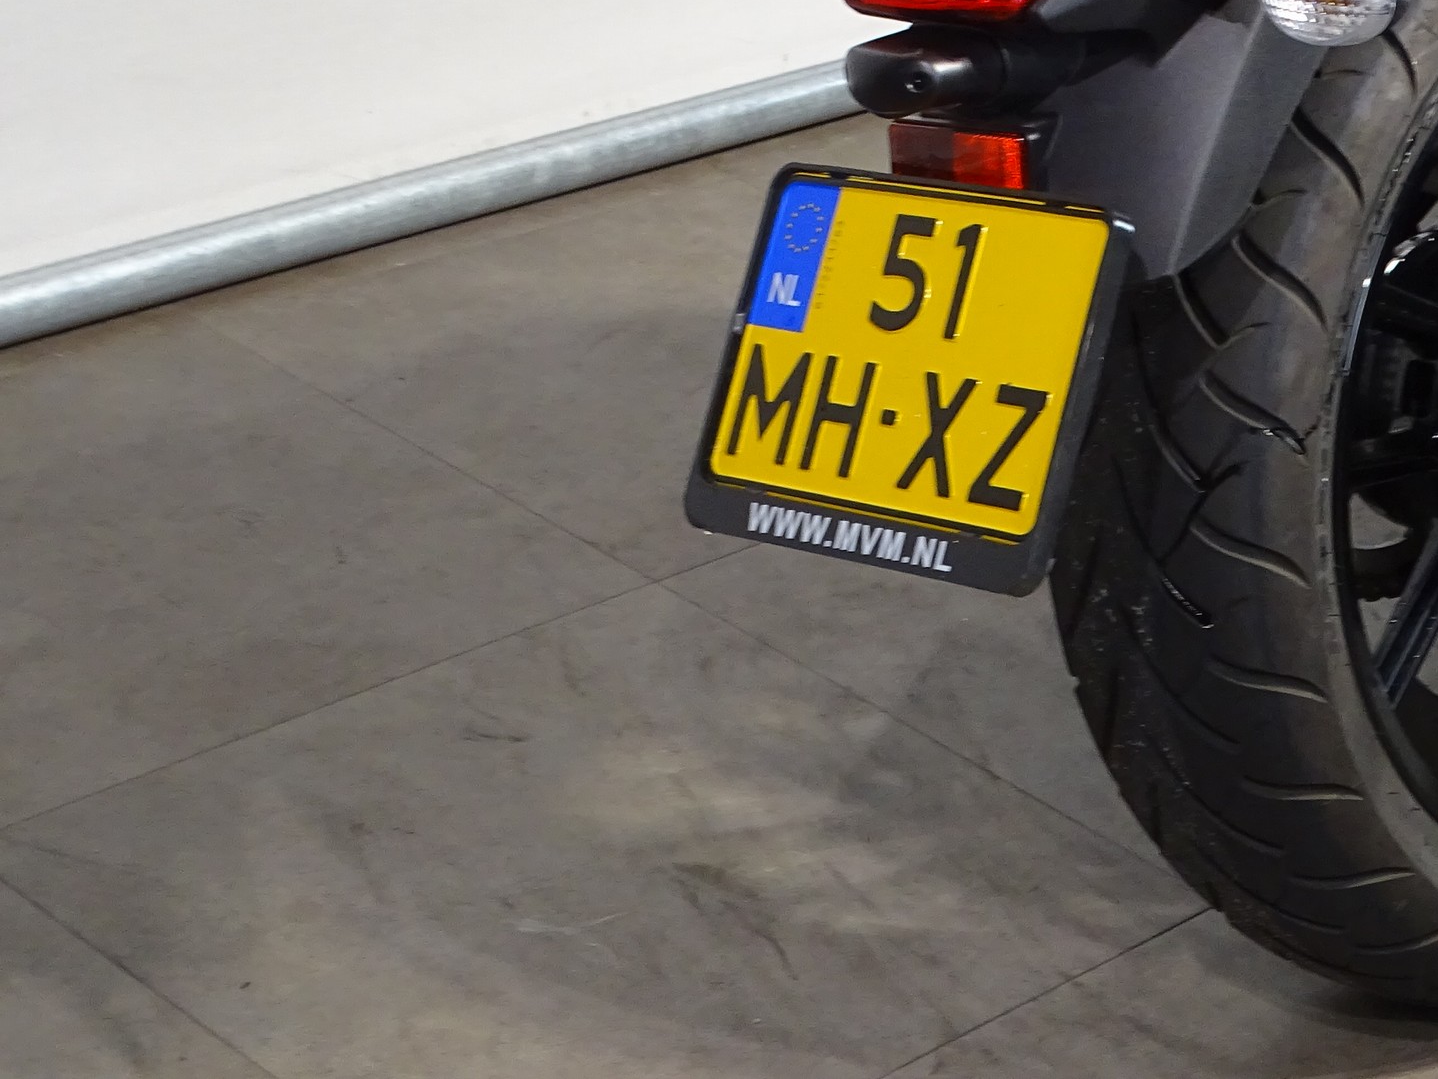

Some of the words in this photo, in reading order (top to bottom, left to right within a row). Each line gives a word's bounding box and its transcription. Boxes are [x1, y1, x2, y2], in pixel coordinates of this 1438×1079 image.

[766, 271, 801, 307] NL
[869, 213, 986, 340] 51
[726, 343, 1051, 512] MH-XZ
[747, 502, 952, 572] WWW.MVM.NL
